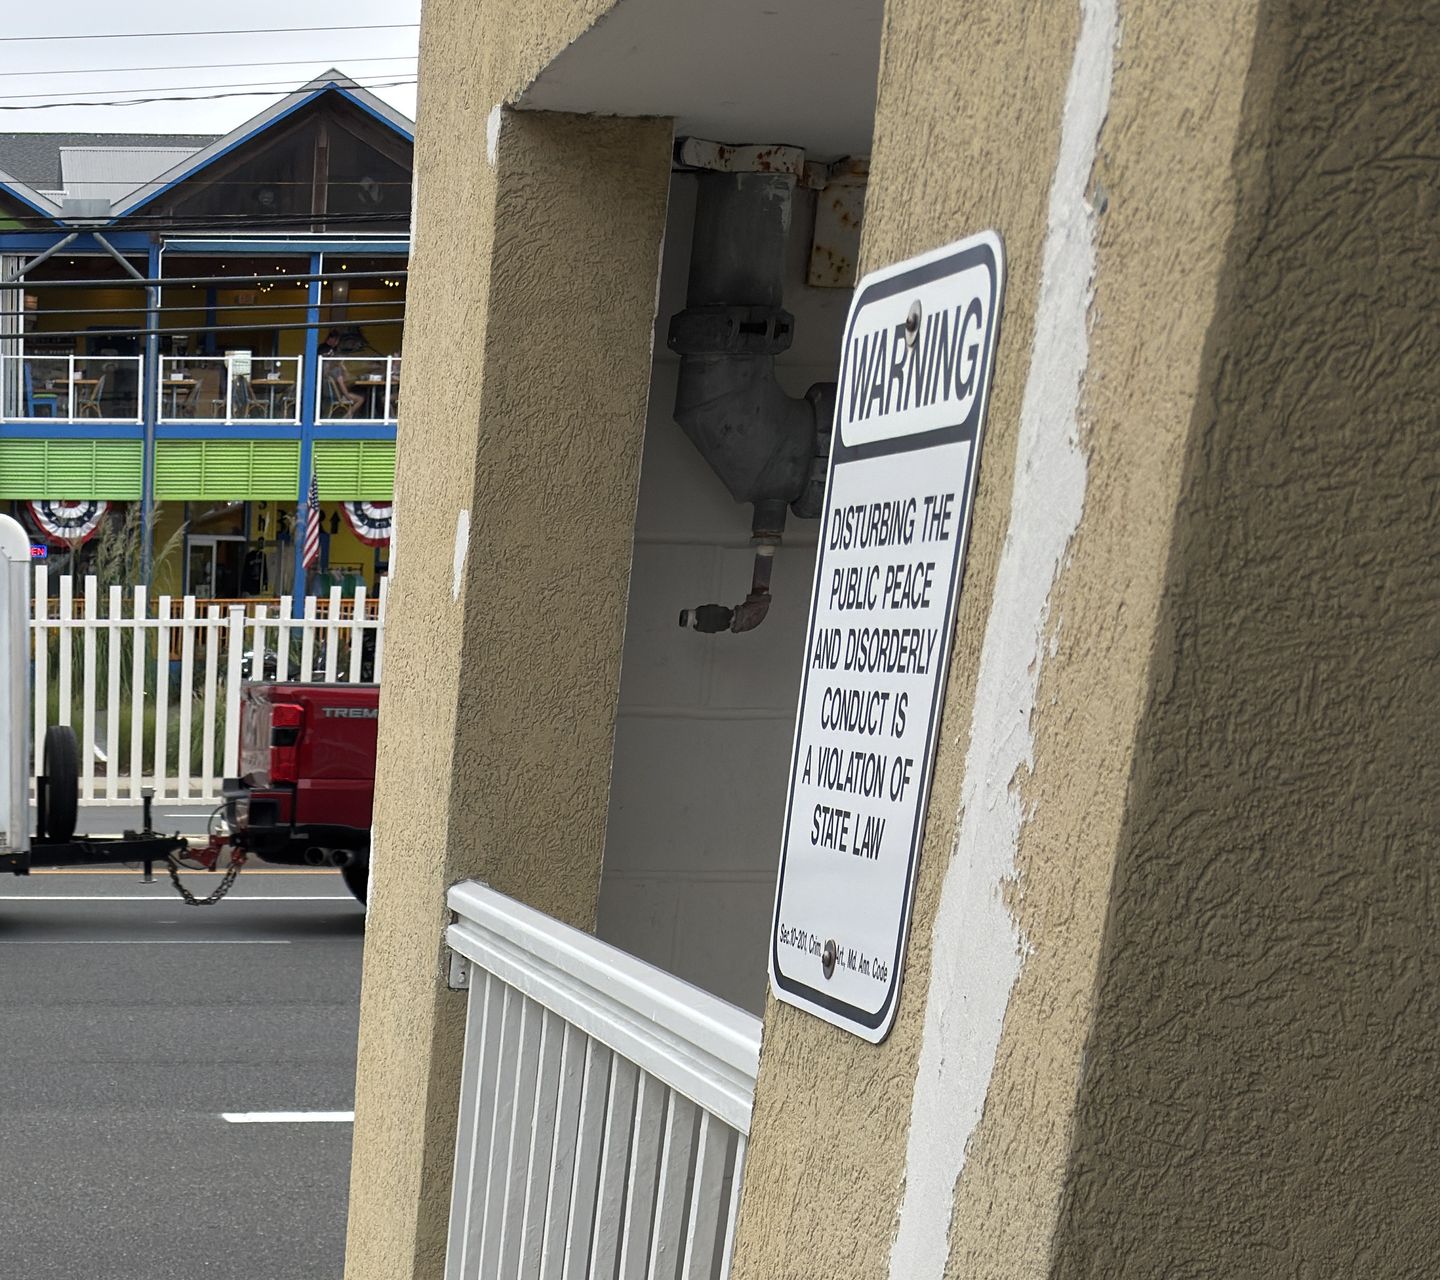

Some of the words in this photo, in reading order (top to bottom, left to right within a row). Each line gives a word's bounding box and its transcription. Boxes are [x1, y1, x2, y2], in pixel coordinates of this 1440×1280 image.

[848, 297, 983, 423] WARNING
[830, 498, 916, 550] DISTURBING
[921, 493, 955, 542] THE
[31, 547, 45, 556] EN
[829, 564, 880, 611] PUBLIC
[882, 562, 936, 610] PEACE
[812, 628, 842, 671] AND
[844, 628, 939, 675] DISORDERLY
[321, 707, 378, 718] TREM
[820, 687, 889, 737] CONDUCT
[891, 691, 909, 739] IS
[802, 745, 813, 785] A
[816, 746, 887, 799] VIOLATION
[890, 756, 914, 803] OF
[811, 803, 851, 853] STATE
[852, 814, 886, 861] LAW
[847, 948, 857, 971] Md.
[872, 957, 888, 983] Code
